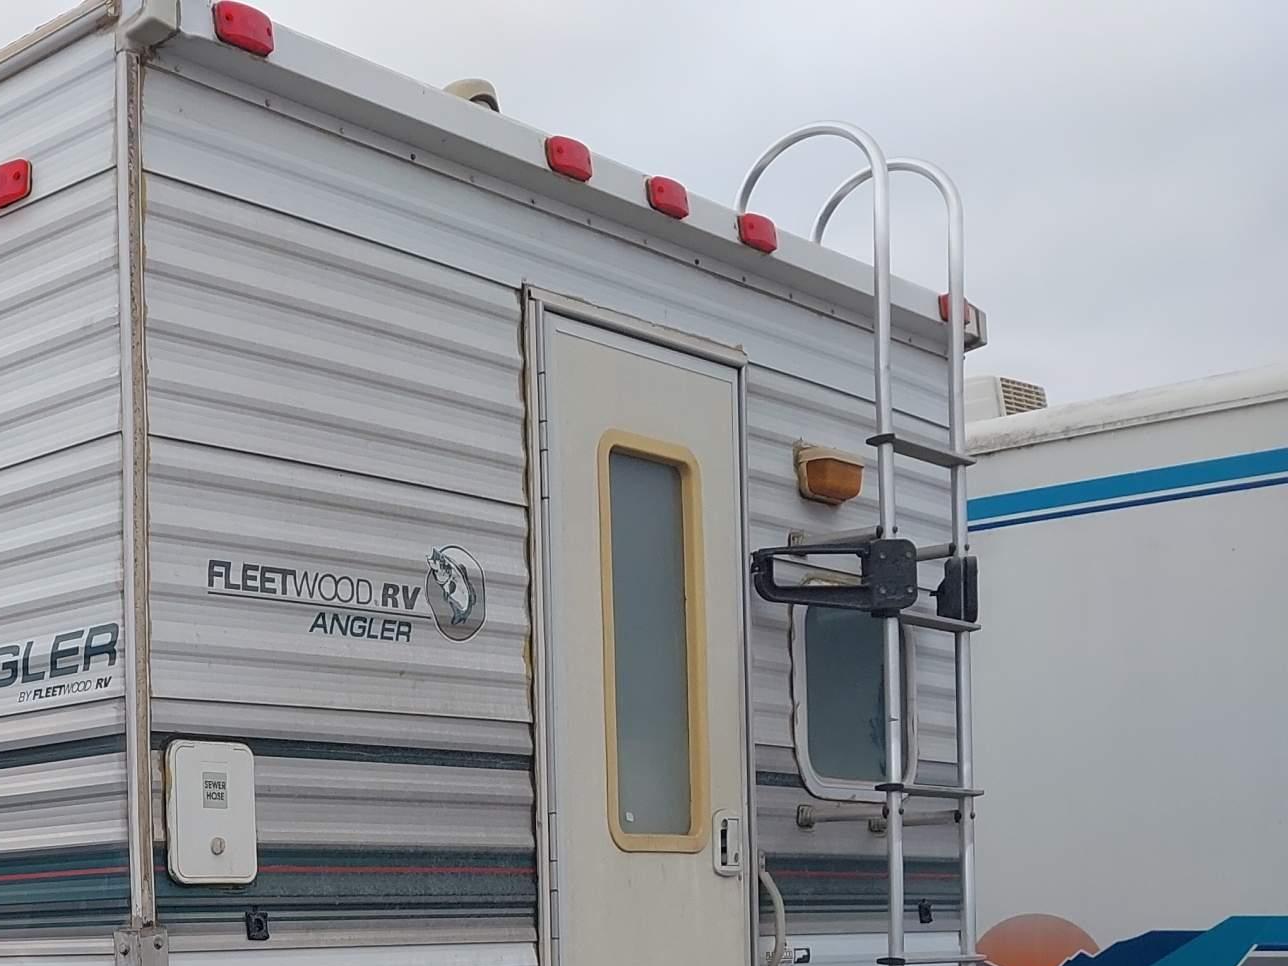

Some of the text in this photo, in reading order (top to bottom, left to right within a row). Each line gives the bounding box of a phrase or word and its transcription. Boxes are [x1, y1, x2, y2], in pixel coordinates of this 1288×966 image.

[208, 559, 422, 610] FLEETWOOD RV
[309, 612, 412, 642] ANGLER
[18, 676, 112, 703] BY FLEETWOOD RV
[204, 780, 226, 790] SEWER
[206, 791, 225, 801] HOSE
